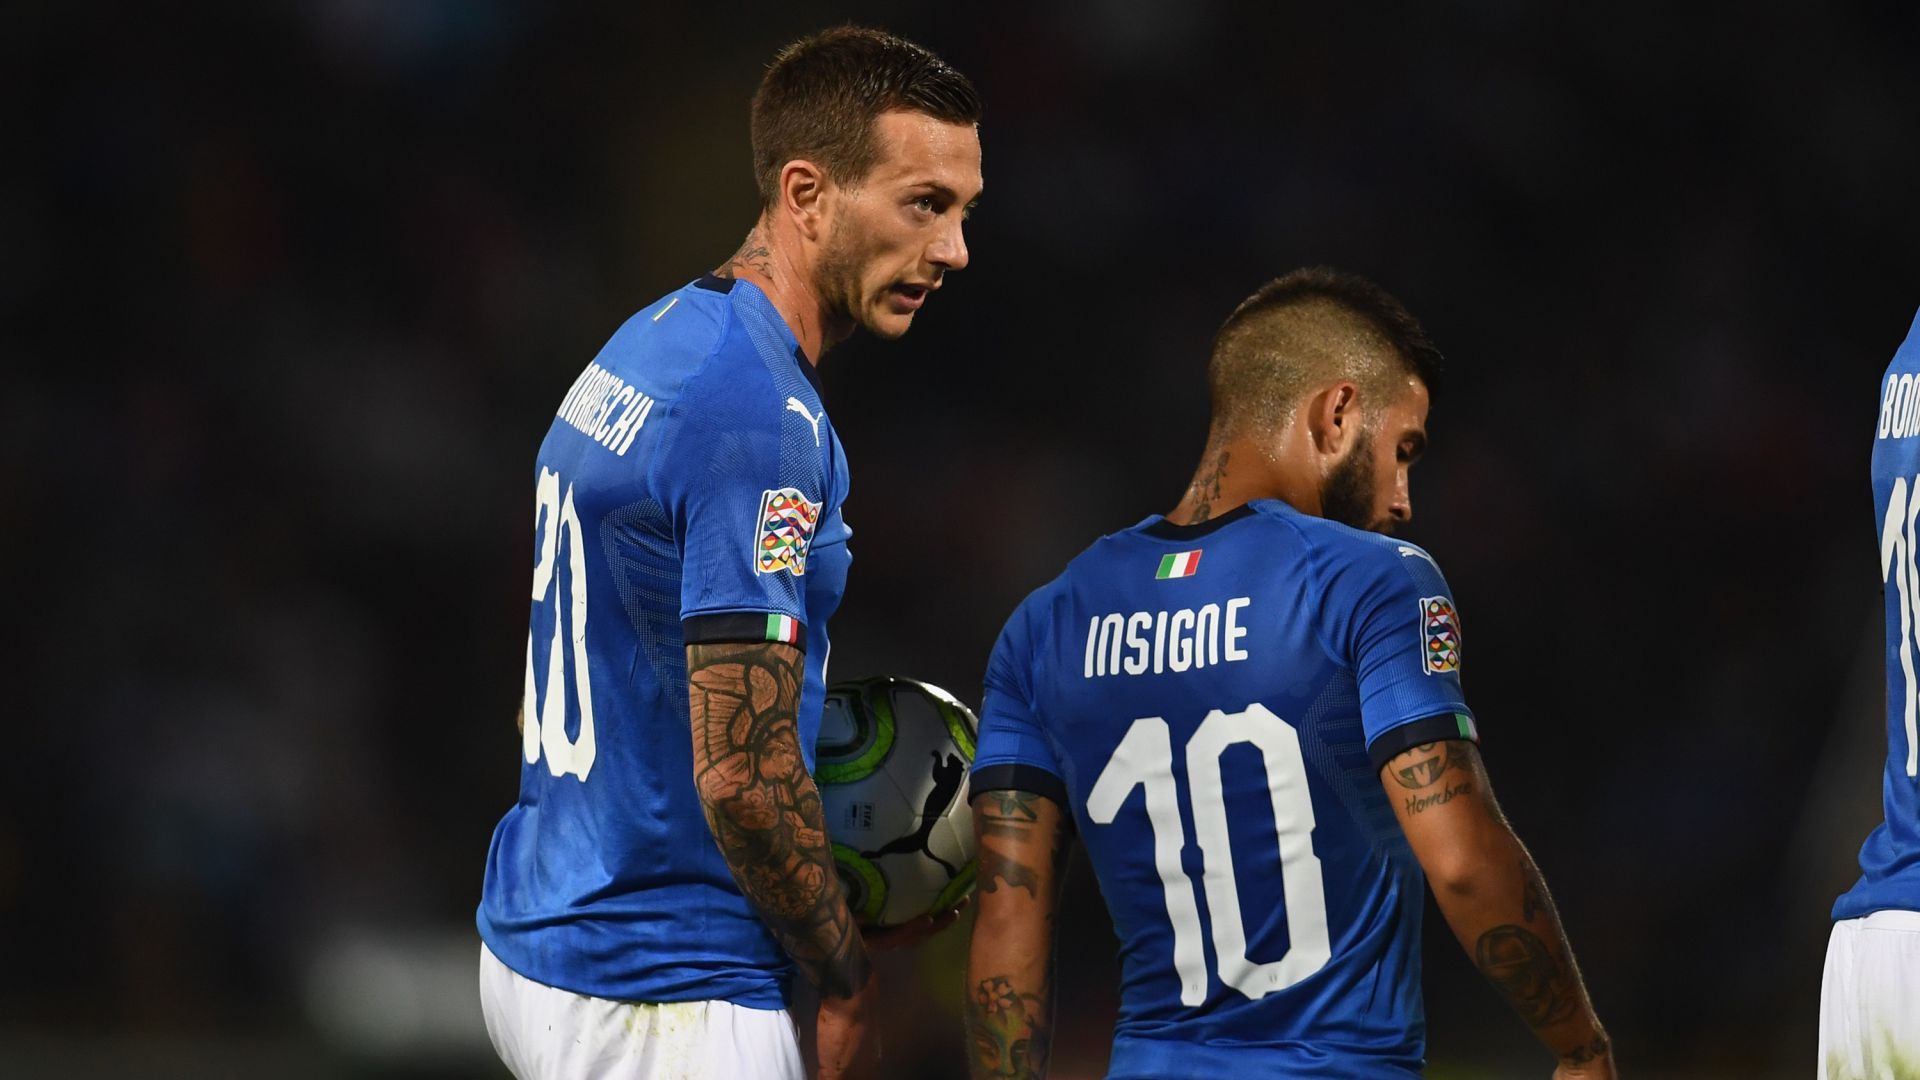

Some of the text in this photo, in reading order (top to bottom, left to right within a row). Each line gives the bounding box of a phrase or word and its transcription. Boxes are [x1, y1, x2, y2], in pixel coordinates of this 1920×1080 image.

[1879, 373, 1920, 439] BON
[1084, 597, 1250, 678] INSIGNE
[1086, 702, 1331, 1007] 10
